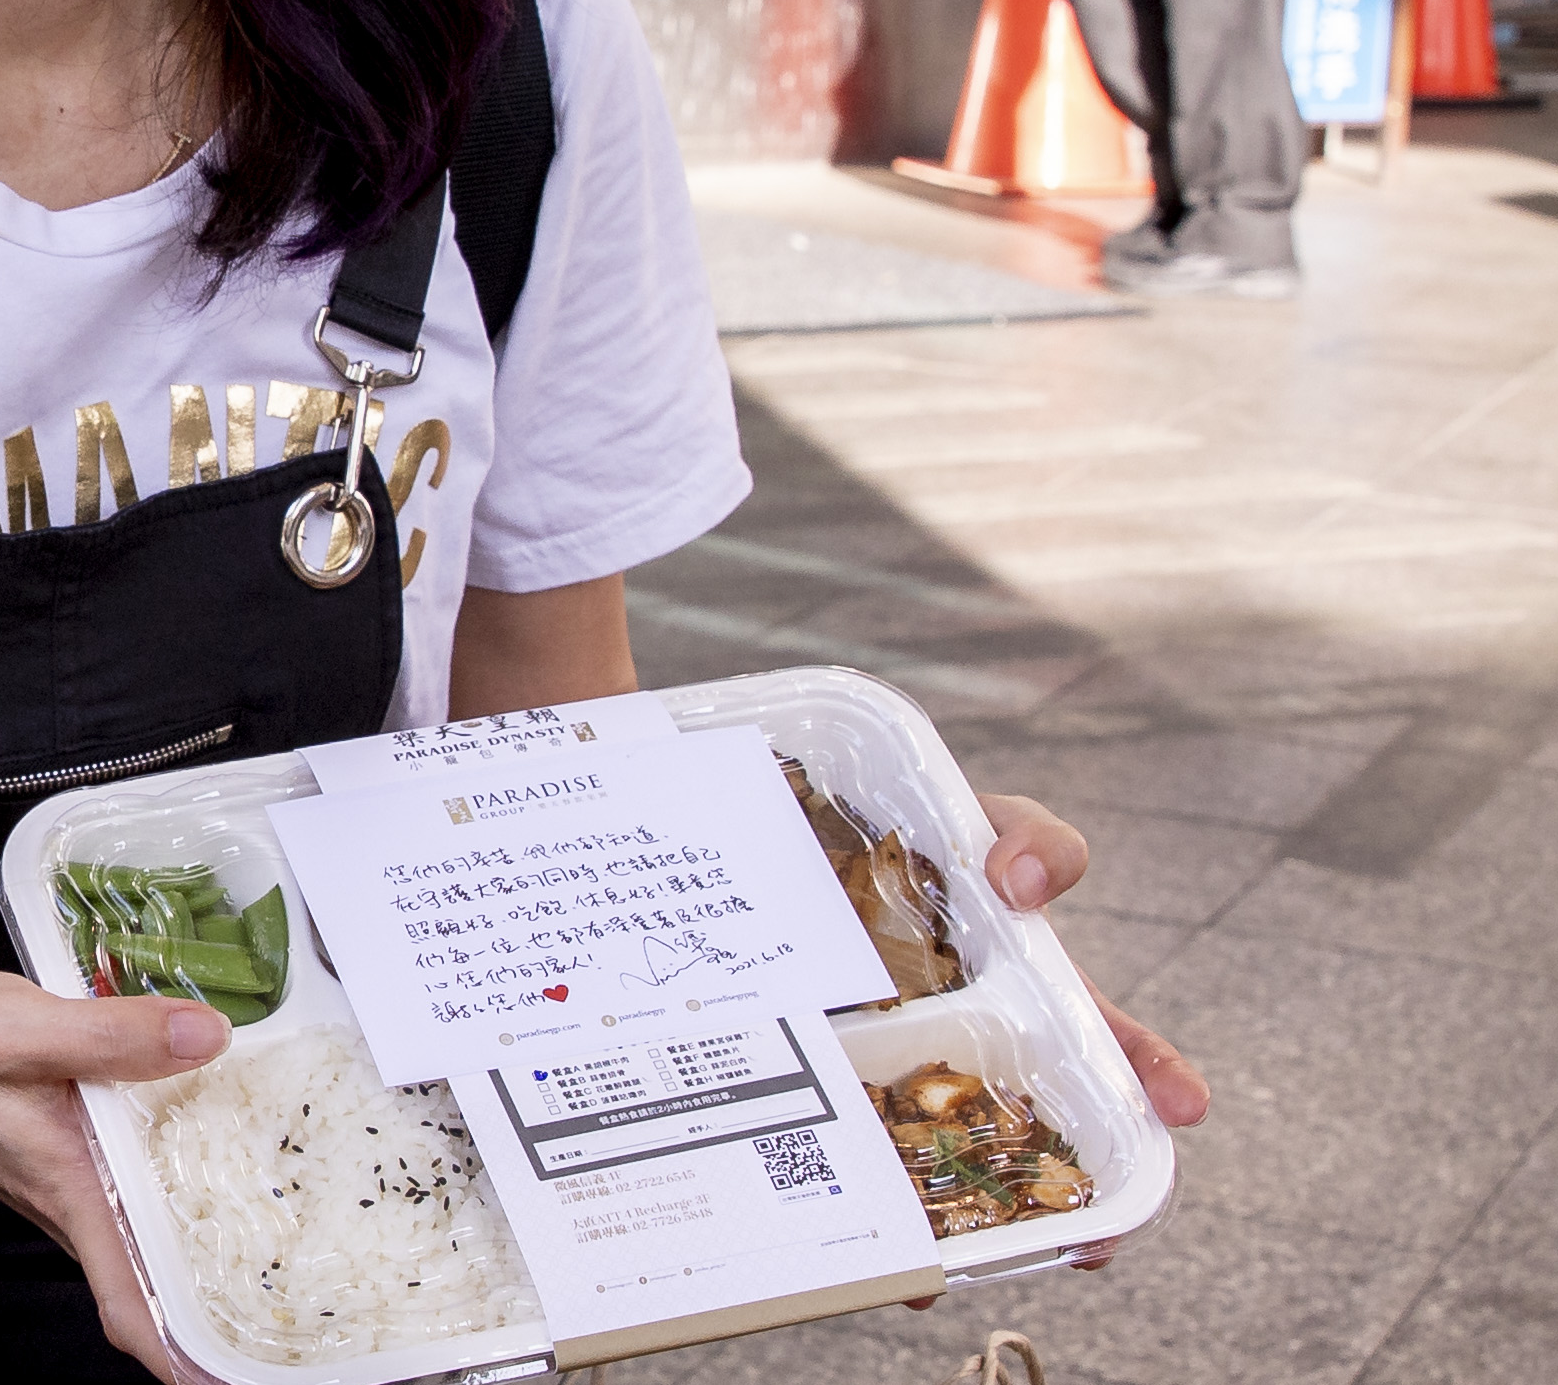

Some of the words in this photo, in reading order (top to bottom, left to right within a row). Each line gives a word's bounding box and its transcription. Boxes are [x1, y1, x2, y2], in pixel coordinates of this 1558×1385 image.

[393, 740, 481, 762] PARADISE
[487, 726, 565, 746] DYNASTY
[410, 738, 561, 771] 小籠包傳奇
[472, 774, 602, 809] PARADISE
[479, 806, 525, 819] GROUP
[716, 943, 793, 975] 2021.6.18
[666, 1042, 695, 1053] 餐盒E
[671, 1053, 700, 1064] 餐盒F
[551, 1065, 580, 1076] 餐盒A
[677, 1064, 707, 1076] 餐盒G
[556, 1076, 586, 1087] 餐盒B
[683, 1075, 713, 1087] 餐盒H
[562, 1087, 592, 1098] 餐盒C
[567, 1098, 597, 1110] 餐盒D
[633, 1197, 695, 1218] Recharge
[681, 1207, 714, 1220] 5848
